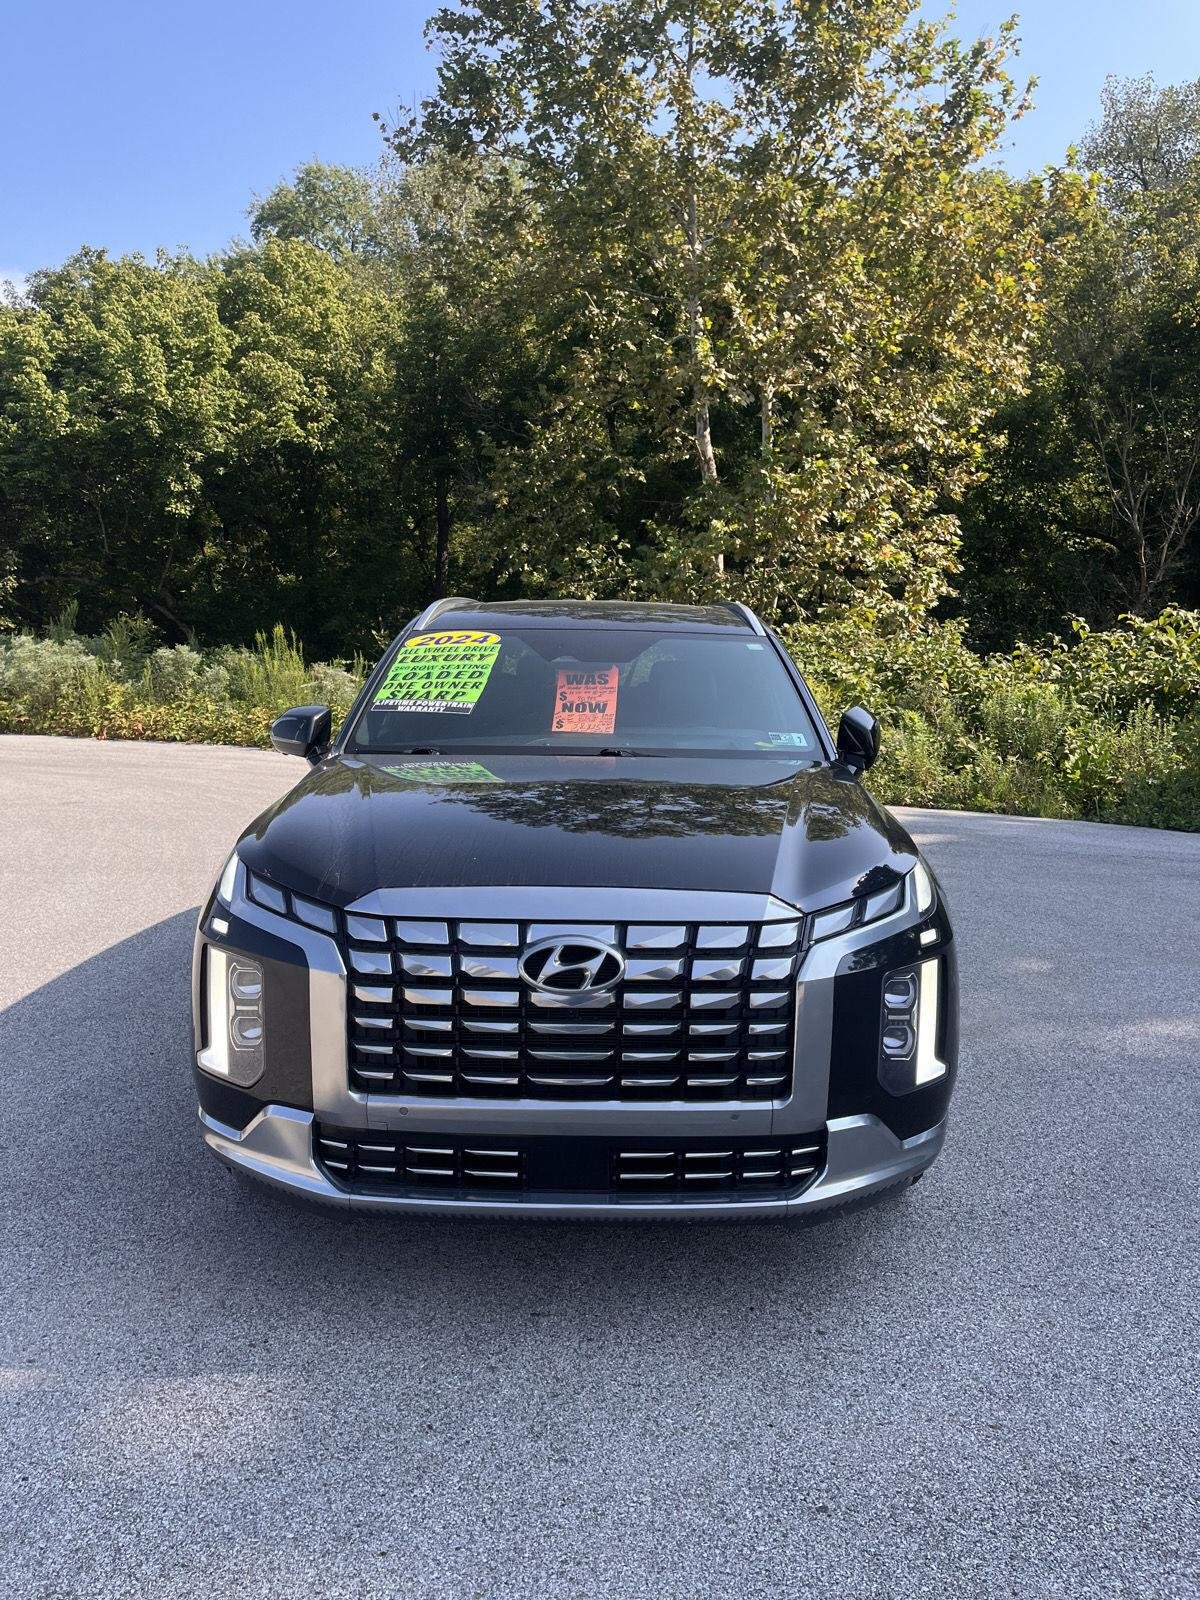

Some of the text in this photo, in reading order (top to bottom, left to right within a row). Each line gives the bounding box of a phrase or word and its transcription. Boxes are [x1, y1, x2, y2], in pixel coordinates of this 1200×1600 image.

[418, 635, 490, 646] 2024
[398, 653, 494, 663] LUXURY
[389, 671, 484, 681] LOADED
[566, 673, 609, 685] WAS
[382, 681, 483, 690] ONE OWNER
[386, 690, 467, 700] SHARP
[560, 691, 567, 702] $
[562, 702, 608, 713] NOW
[556, 719, 564, 729] $
